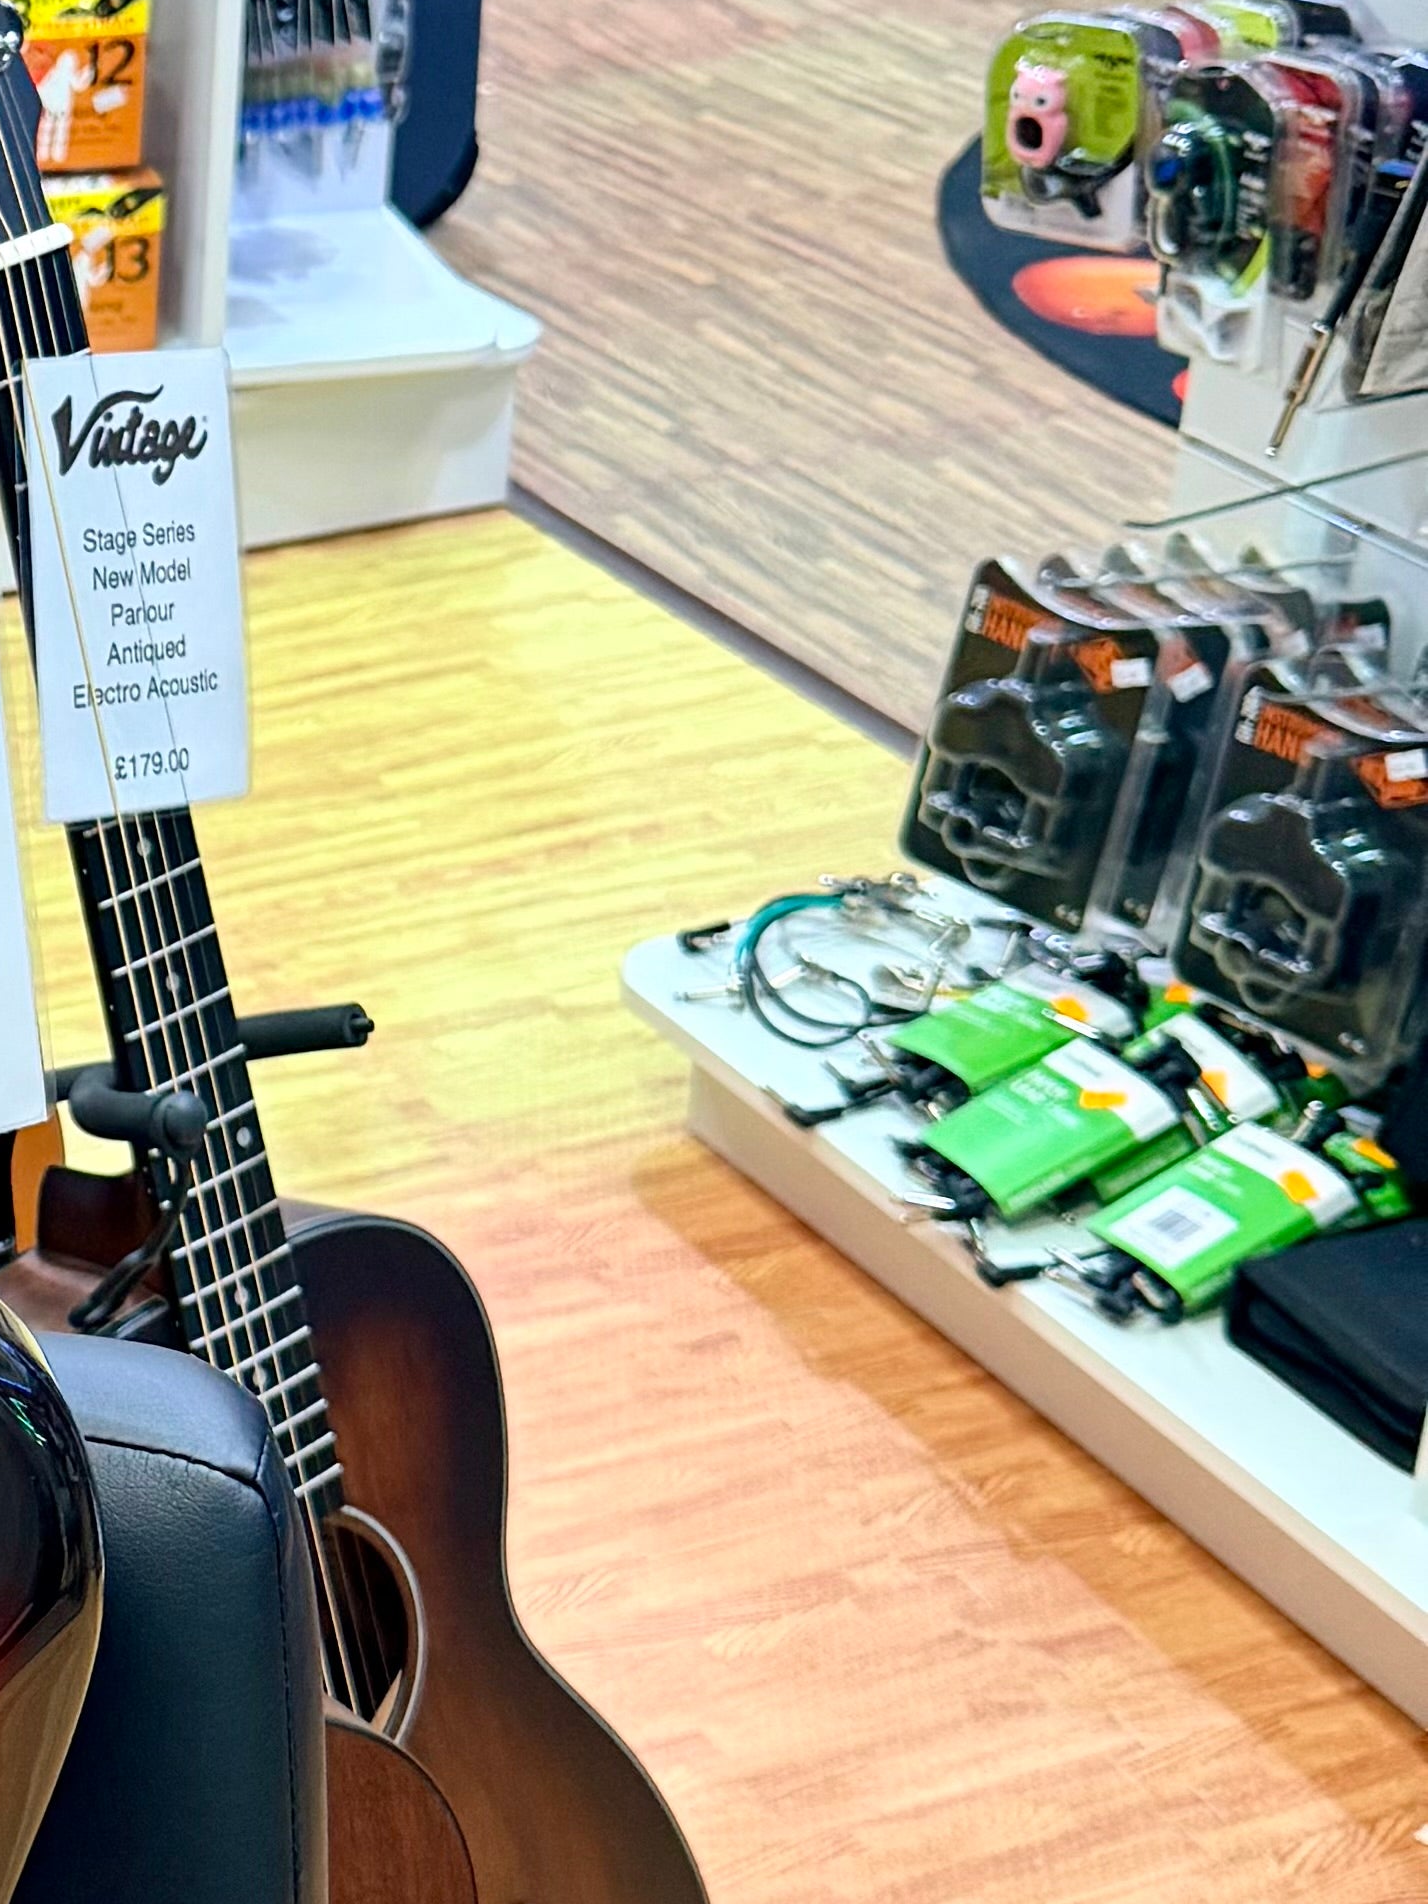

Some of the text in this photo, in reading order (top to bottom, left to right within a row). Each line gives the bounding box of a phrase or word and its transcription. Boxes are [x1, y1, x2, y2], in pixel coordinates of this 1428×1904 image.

[88, 39, 135, 87] 12
[51, 384, 207, 486] Vintage
[83, 520, 195, 556] Stage Series
[93, 558, 191, 590] New Model
[110, 600, 174, 626] Parlour
[107, 634, 186, 667] Antiqued
[72, 669, 219, 709] Electro Acoustic
[114, 747, 189, 780] £179.00
